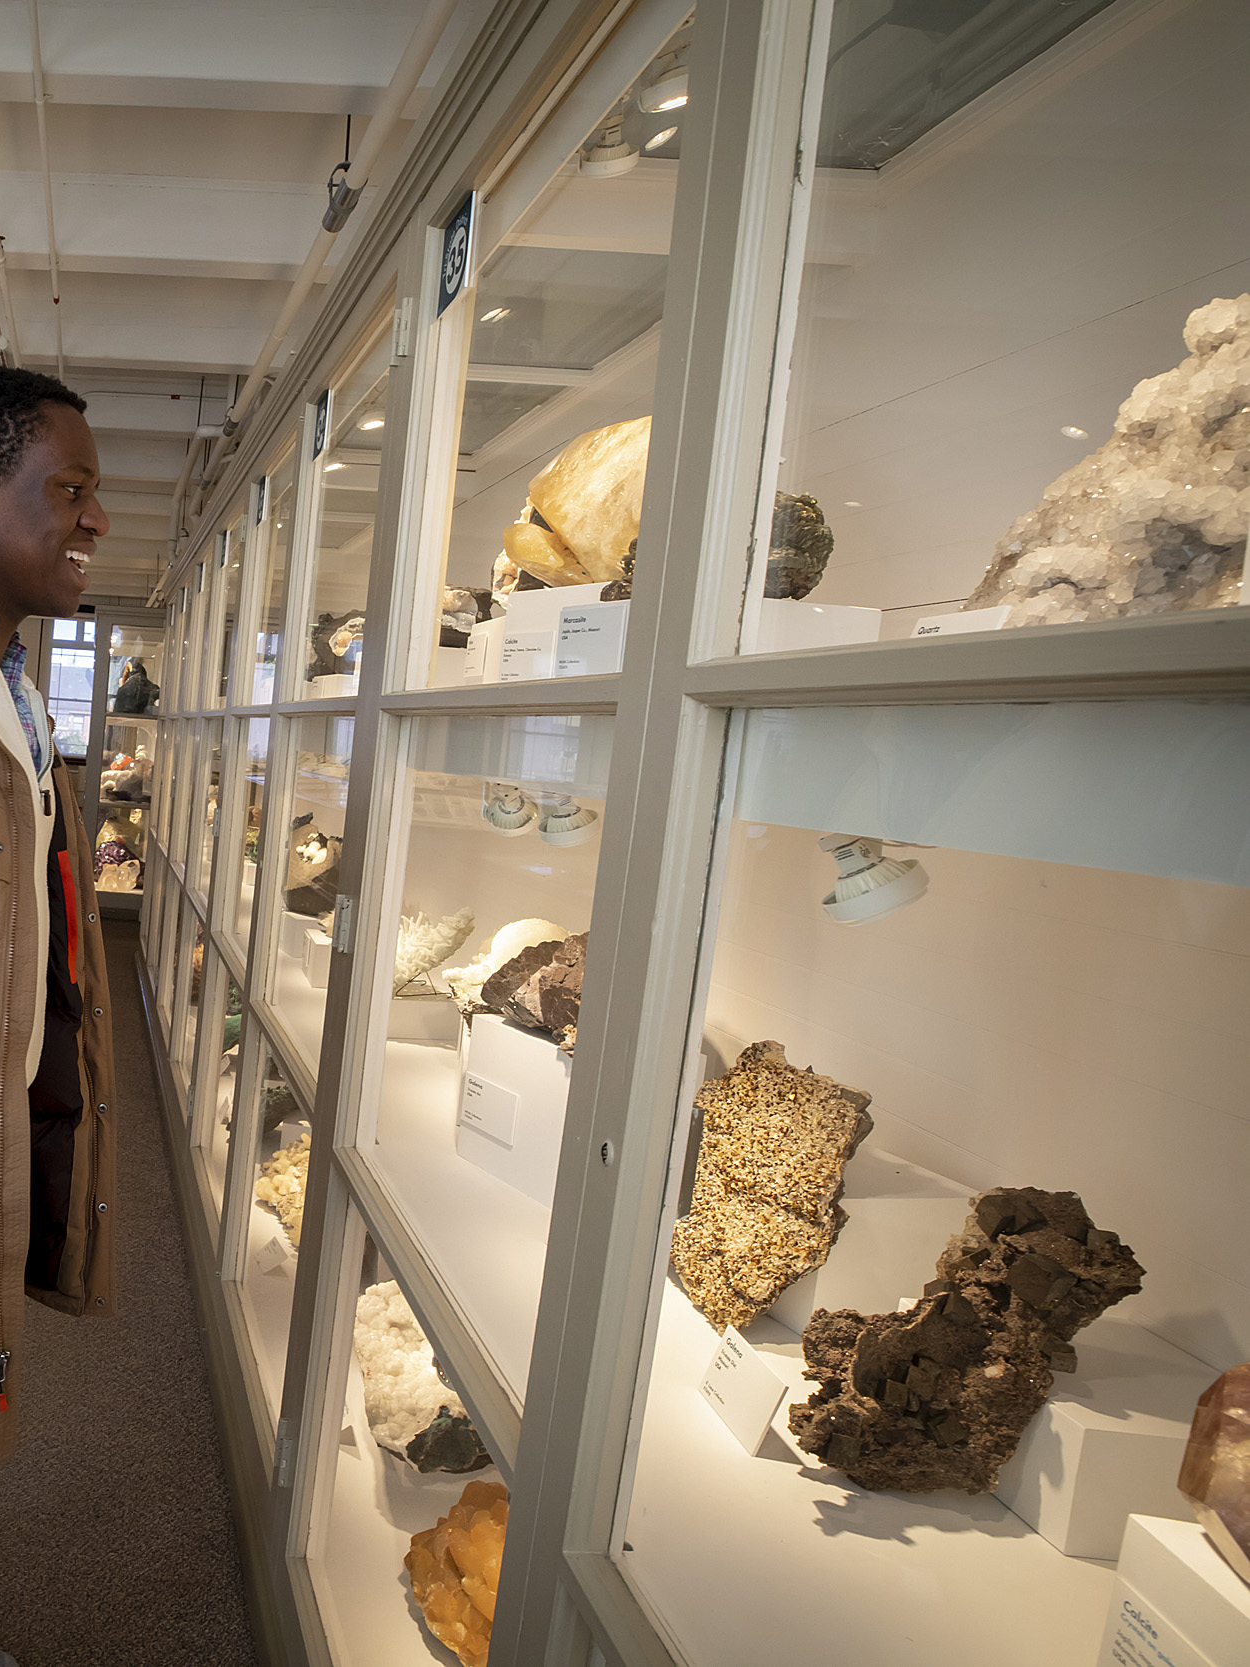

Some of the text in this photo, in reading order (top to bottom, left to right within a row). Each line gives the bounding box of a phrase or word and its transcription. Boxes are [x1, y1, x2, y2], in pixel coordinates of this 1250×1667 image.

[447, 235, 465, 284] 35
[563, 616, 587, 624] Marcasite
[917, 626, 941, 635] Quartz
[468, 1078, 483, 1090] Galena
[726, 1337, 743, 1359] Galena
[1123, 1600, 1159, 1640] Calcite
